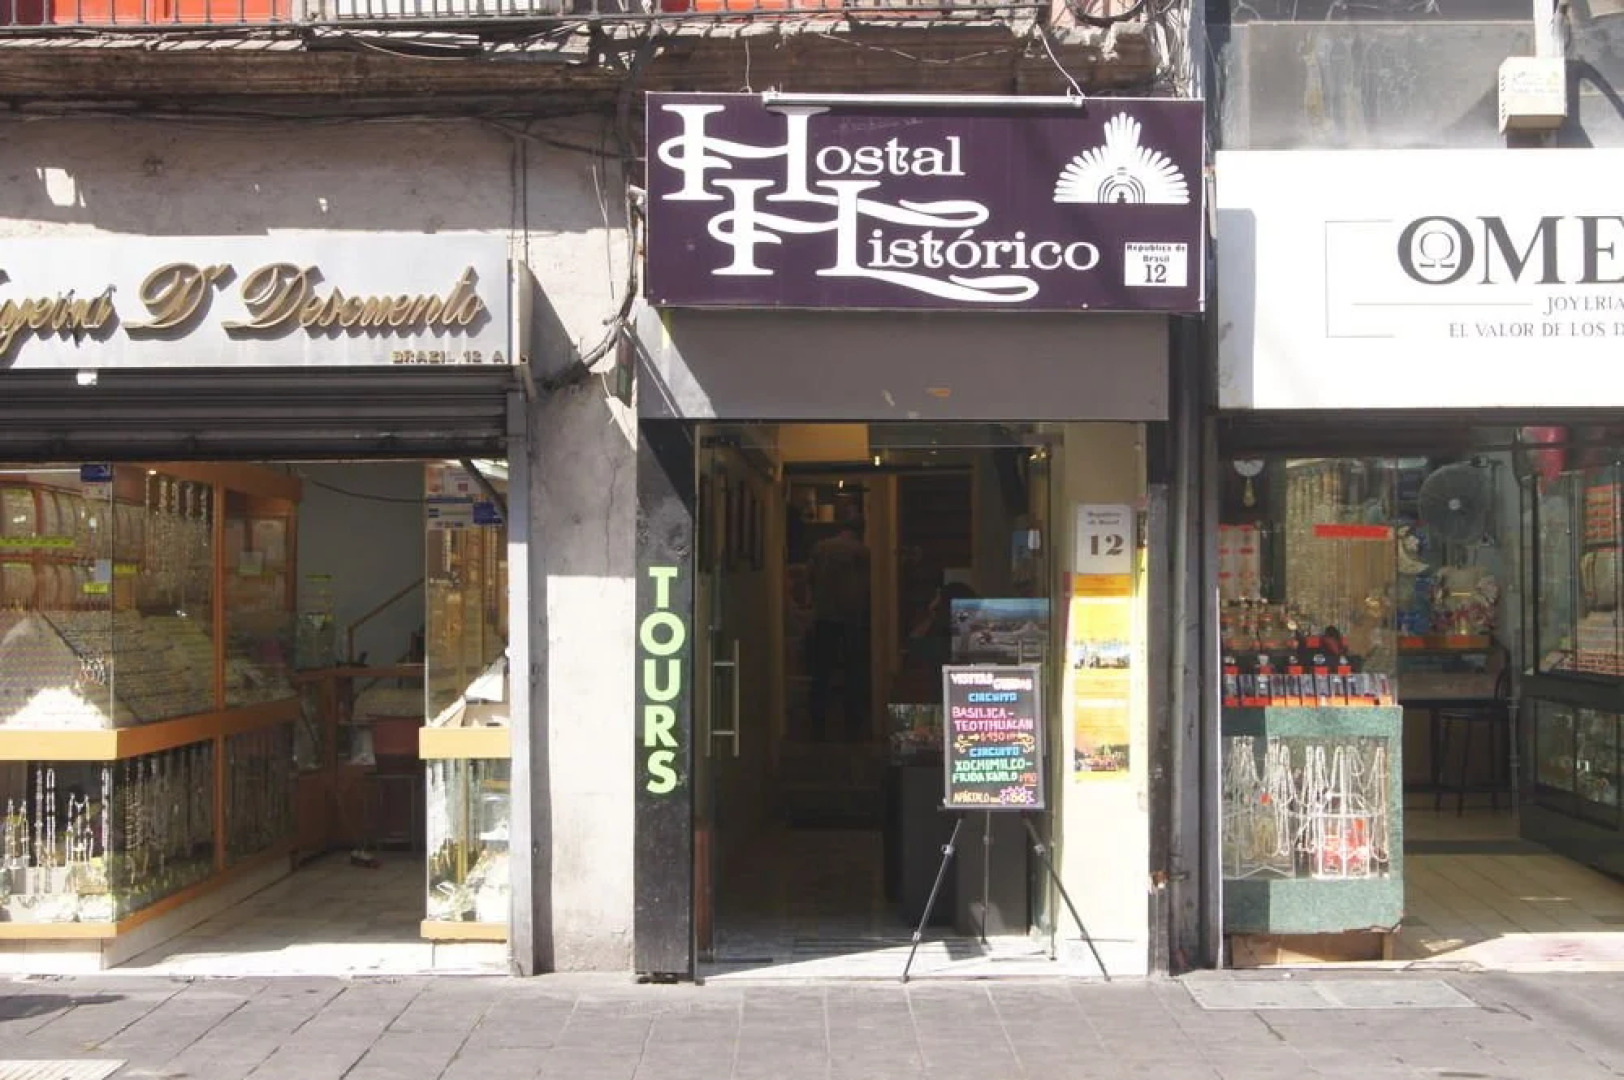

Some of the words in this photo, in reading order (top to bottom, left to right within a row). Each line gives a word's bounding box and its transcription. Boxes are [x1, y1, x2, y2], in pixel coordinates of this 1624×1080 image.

[658, 104, 989, 227] Hostal
[708, 178, 1101, 302] Histórico
[1397, 215, 1624, 285] OME
[1144, 264, 1167, 283] 12
[1449, 322, 1469, 338] EL
[1475, 322, 1534, 338] VALOR
[1542, 322, 1561, 338] DE
[1571, 322, 1606, 338] LOS
[391, 350, 456, 364] BRAZIL
[462, 350, 482, 363] 12
[491, 350, 505, 363] A
[1090, 534, 1125, 556] 12
[639, 566, 686, 794] TOURS
